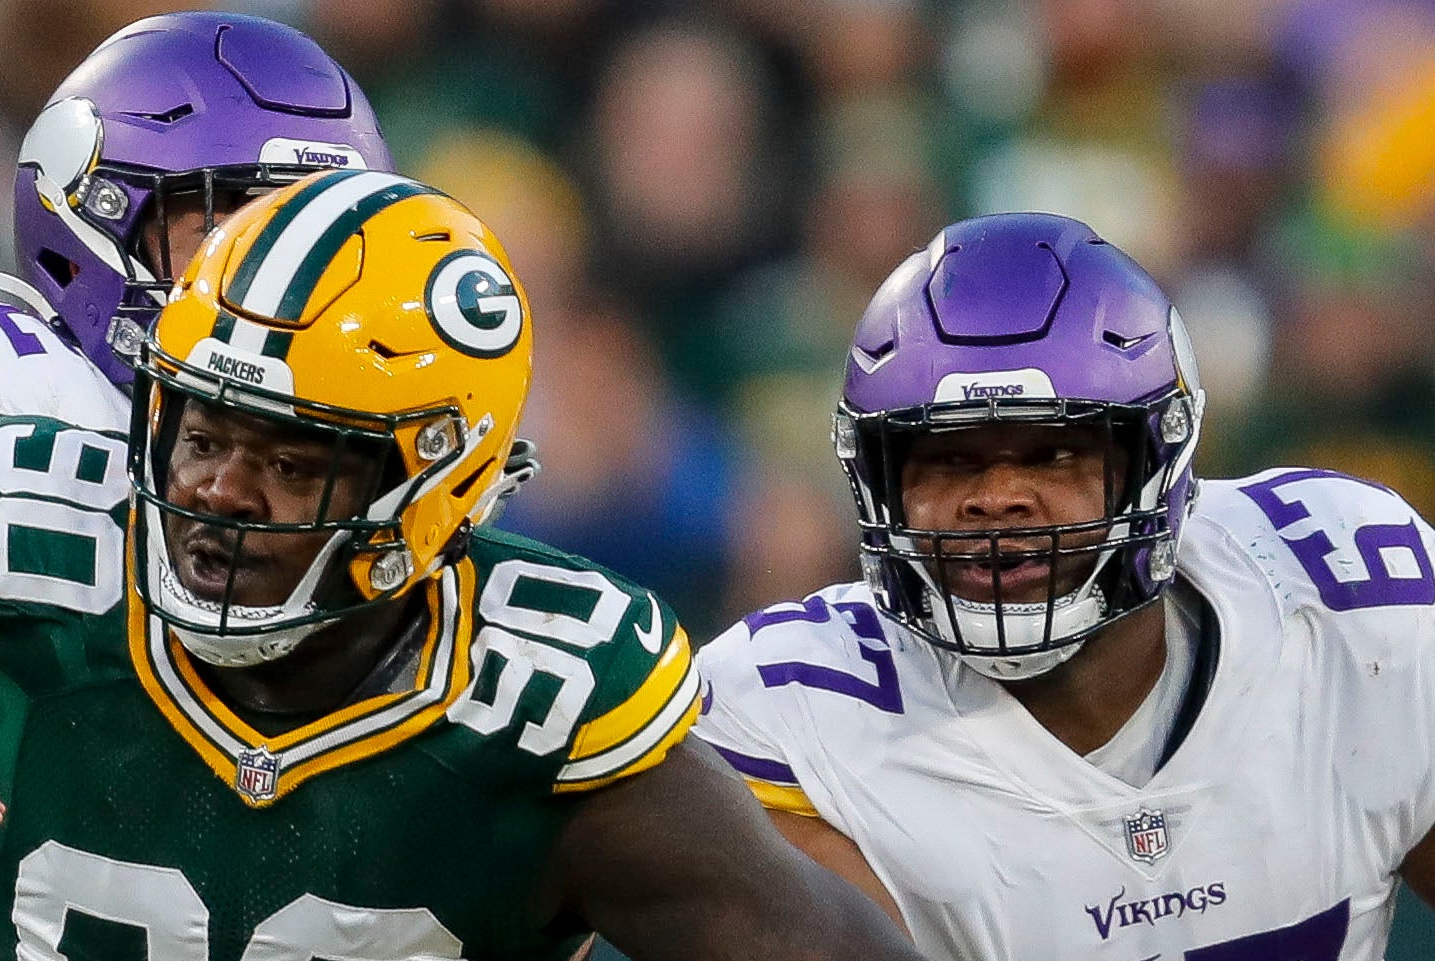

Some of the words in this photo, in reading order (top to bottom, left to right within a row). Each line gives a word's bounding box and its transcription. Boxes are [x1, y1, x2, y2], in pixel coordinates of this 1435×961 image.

[293, 147, 349, 166] VIKINGS
[430, 254, 522, 351] G
[208, 351, 265, 384] PACKERS
[961, 381, 1024, 400] VIKINGS
[448, 559, 631, 757] 90
[1085, 882, 1226, 939] VIKINGS
